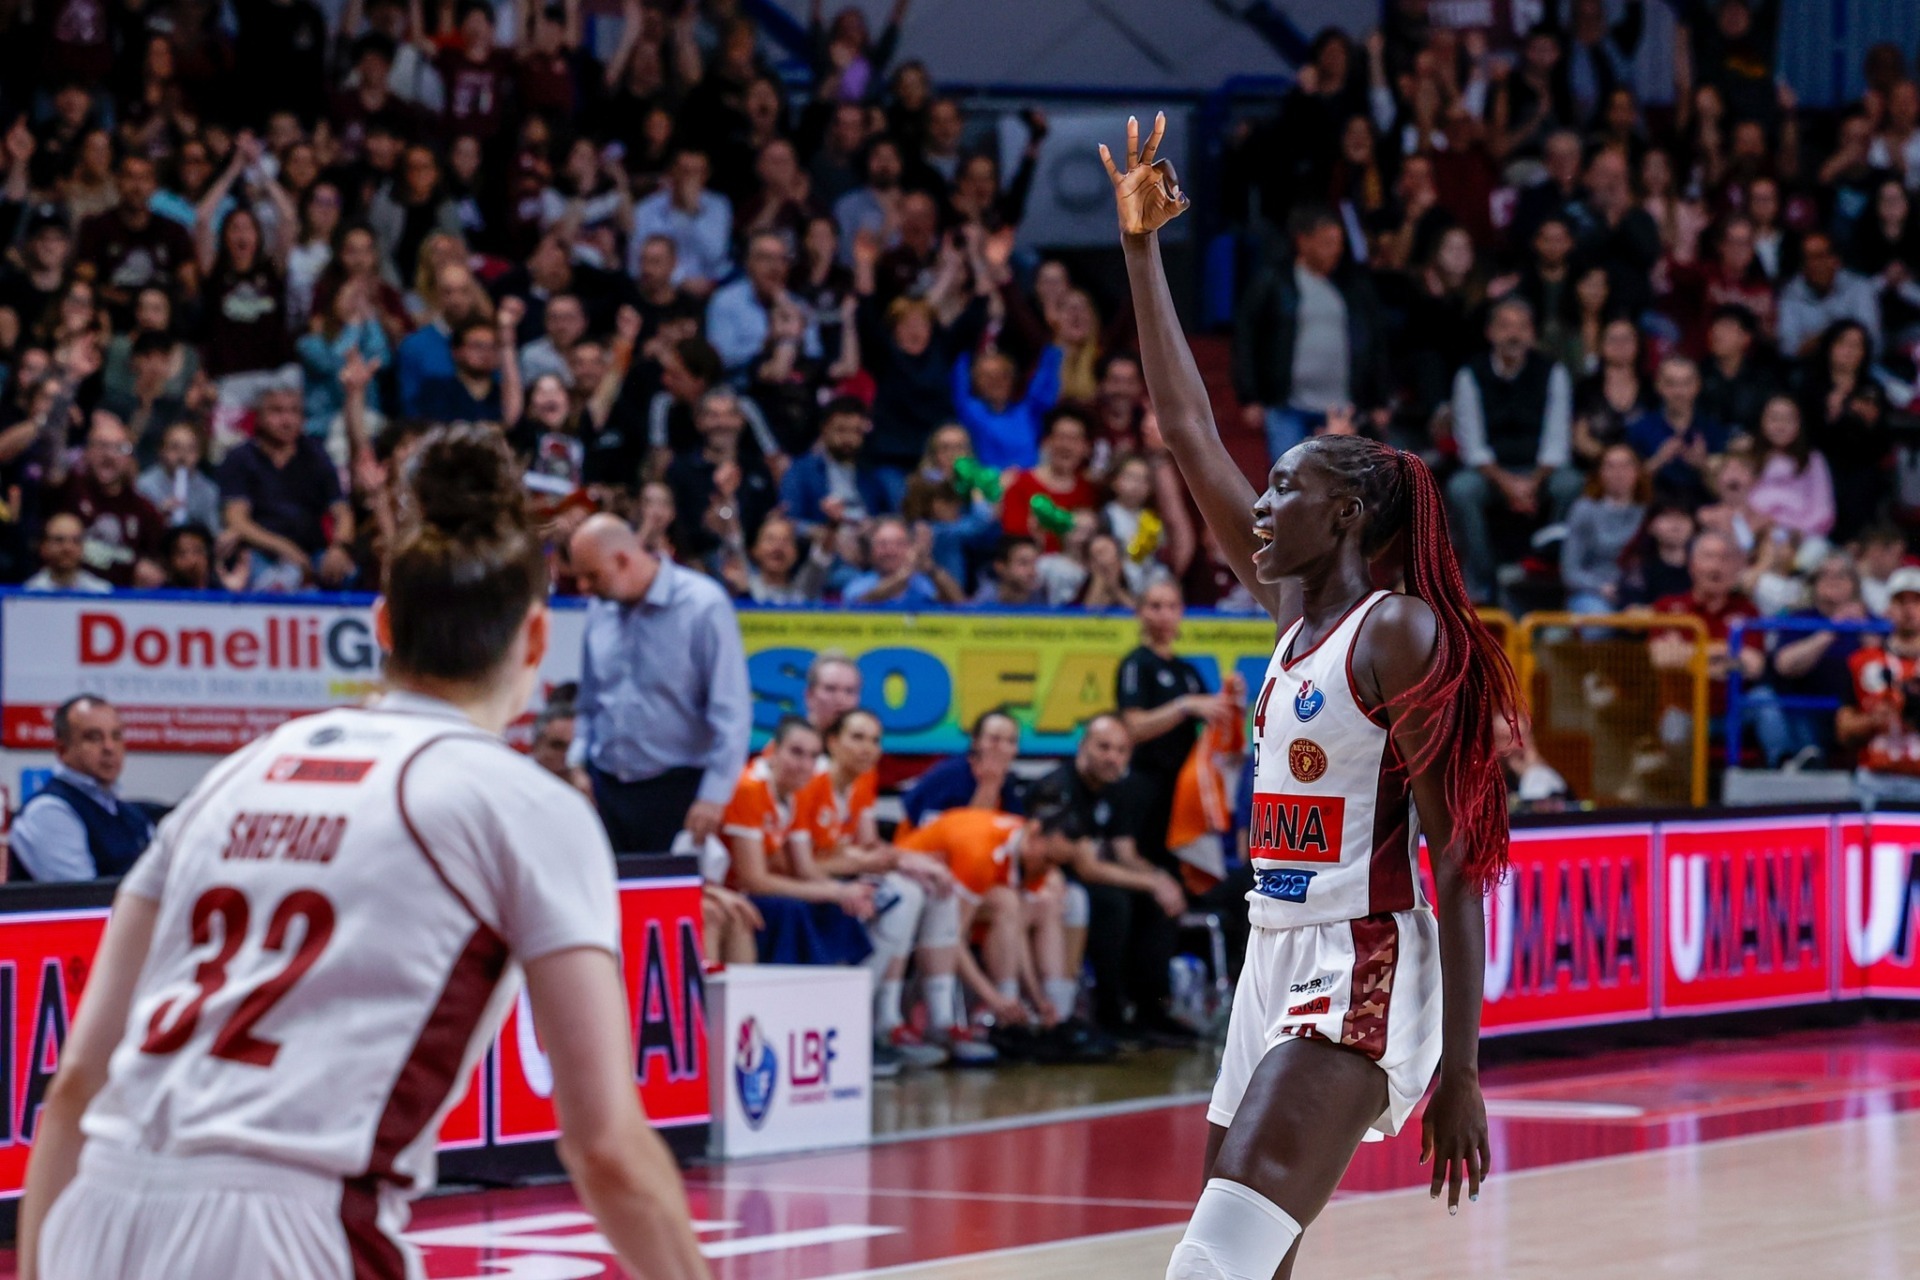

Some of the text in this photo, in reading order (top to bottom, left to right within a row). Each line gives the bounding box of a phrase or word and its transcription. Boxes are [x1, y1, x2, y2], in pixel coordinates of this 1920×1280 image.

[79, 610, 384, 670] DonelliG
[1299, 700, 1316, 711] LBF
[222, 811, 348, 867] SHEPARD
[1250, 802, 1328, 853] MANA
[1484, 856, 1641, 1003] UMANA
[1670, 850, 1819, 983] UMANA
[140, 886, 335, 1067] 32
[788, 1028, 837, 1085] LBF
